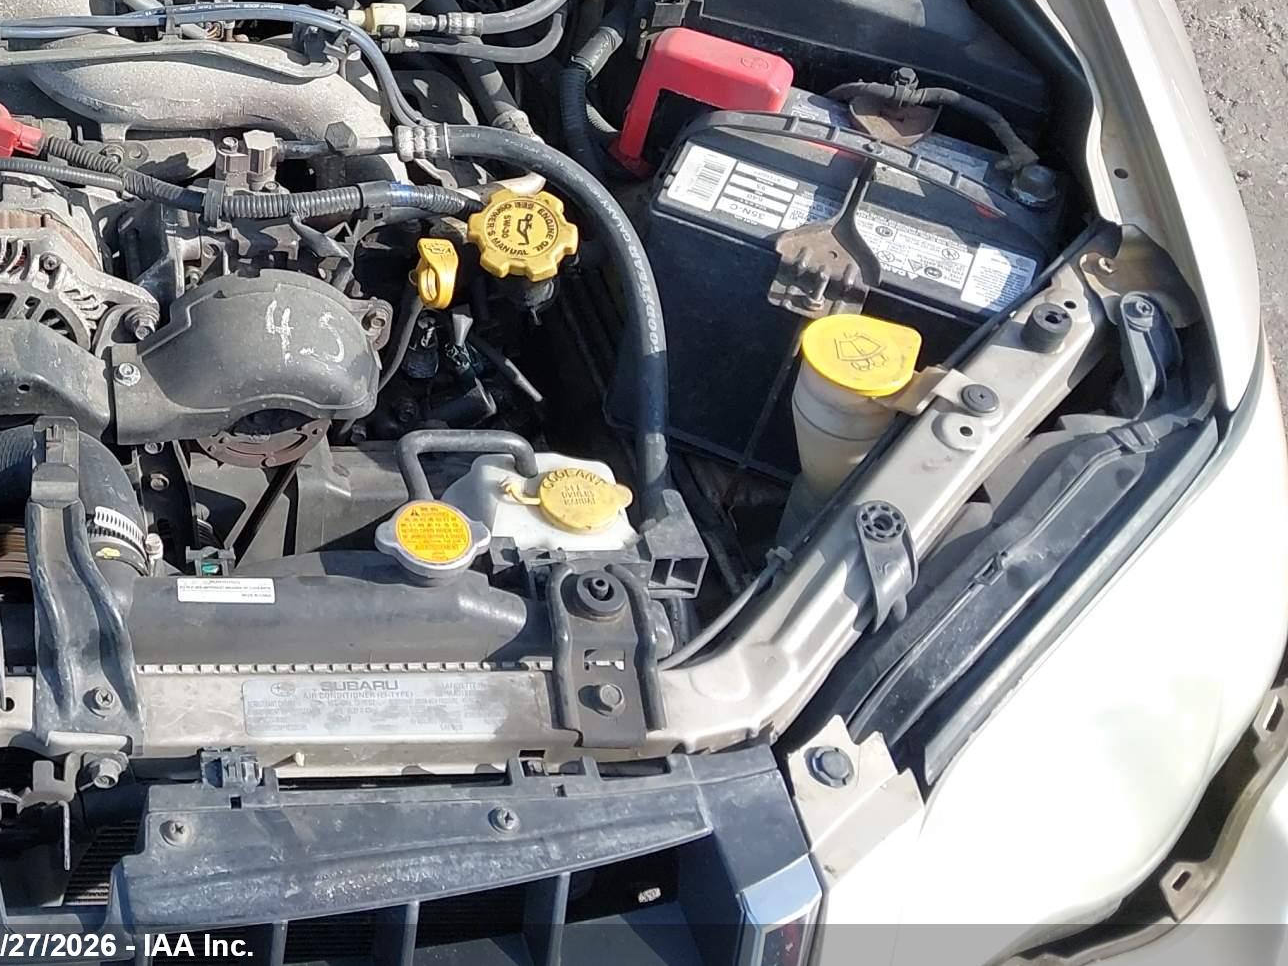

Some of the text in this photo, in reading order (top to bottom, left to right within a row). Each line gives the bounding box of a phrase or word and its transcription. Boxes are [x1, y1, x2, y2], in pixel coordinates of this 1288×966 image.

[501, 214, 512, 240] 5W-30
[532, 208, 557, 253] ENGINE OIL
[600, 199, 632, 243] GALAXY
[492, 237, 529, 256] MANUAL
[320, 679, 399, 692] SUBARU
